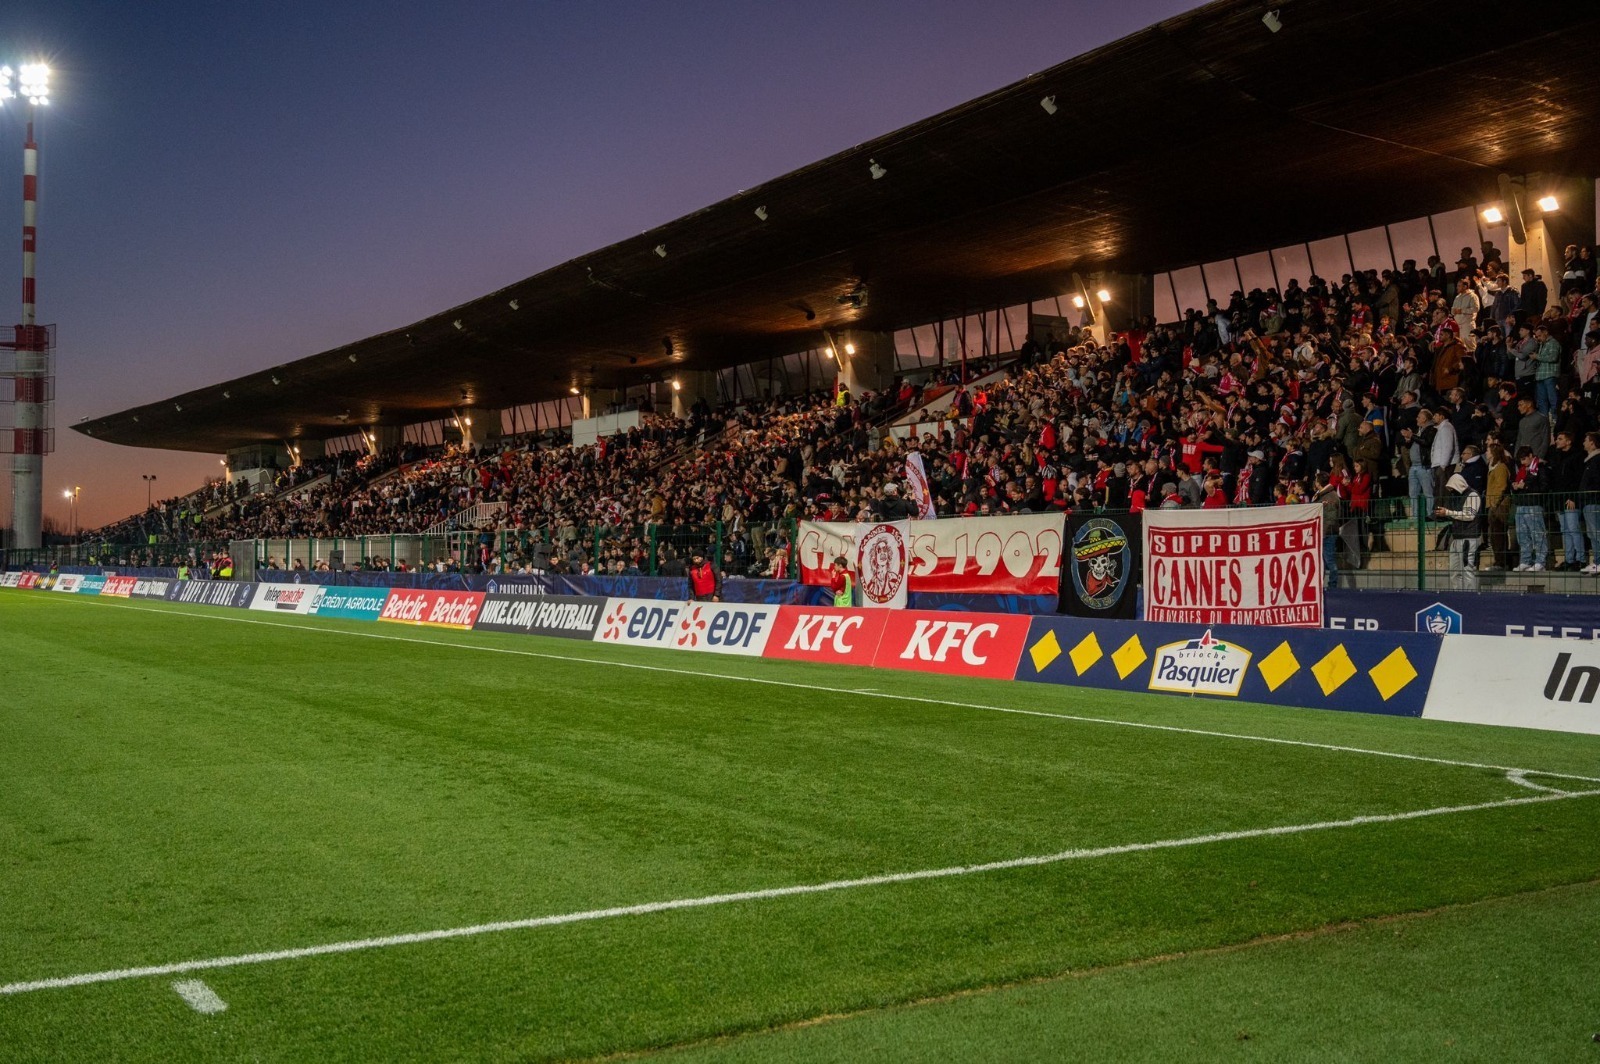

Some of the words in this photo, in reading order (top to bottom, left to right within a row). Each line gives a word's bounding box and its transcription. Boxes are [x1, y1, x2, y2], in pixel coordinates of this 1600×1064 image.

[800, 531, 938, 576] CAS
[953, 529, 1061, 578] 1902
[1153, 527, 1314, 553] SUPPORTER
[1153, 558, 1242, 607] CANNES
[1254, 552, 1317, 606] 1902
[321, 594, 347, 609] CRÉDIT
[344, 597, 385, 611] AGRICOLE
[382, 594, 428, 621] Betclic
[428, 596, 477, 624] Betclic
[478, 600, 599, 631] NIKE.COM/FOOTBALL
[784, 614, 863, 654] KFC
[900, 620, 999, 665] KFC
[1157, 655, 1240, 688] Pasquier
[1178, 651, 1227, 661] brioche
